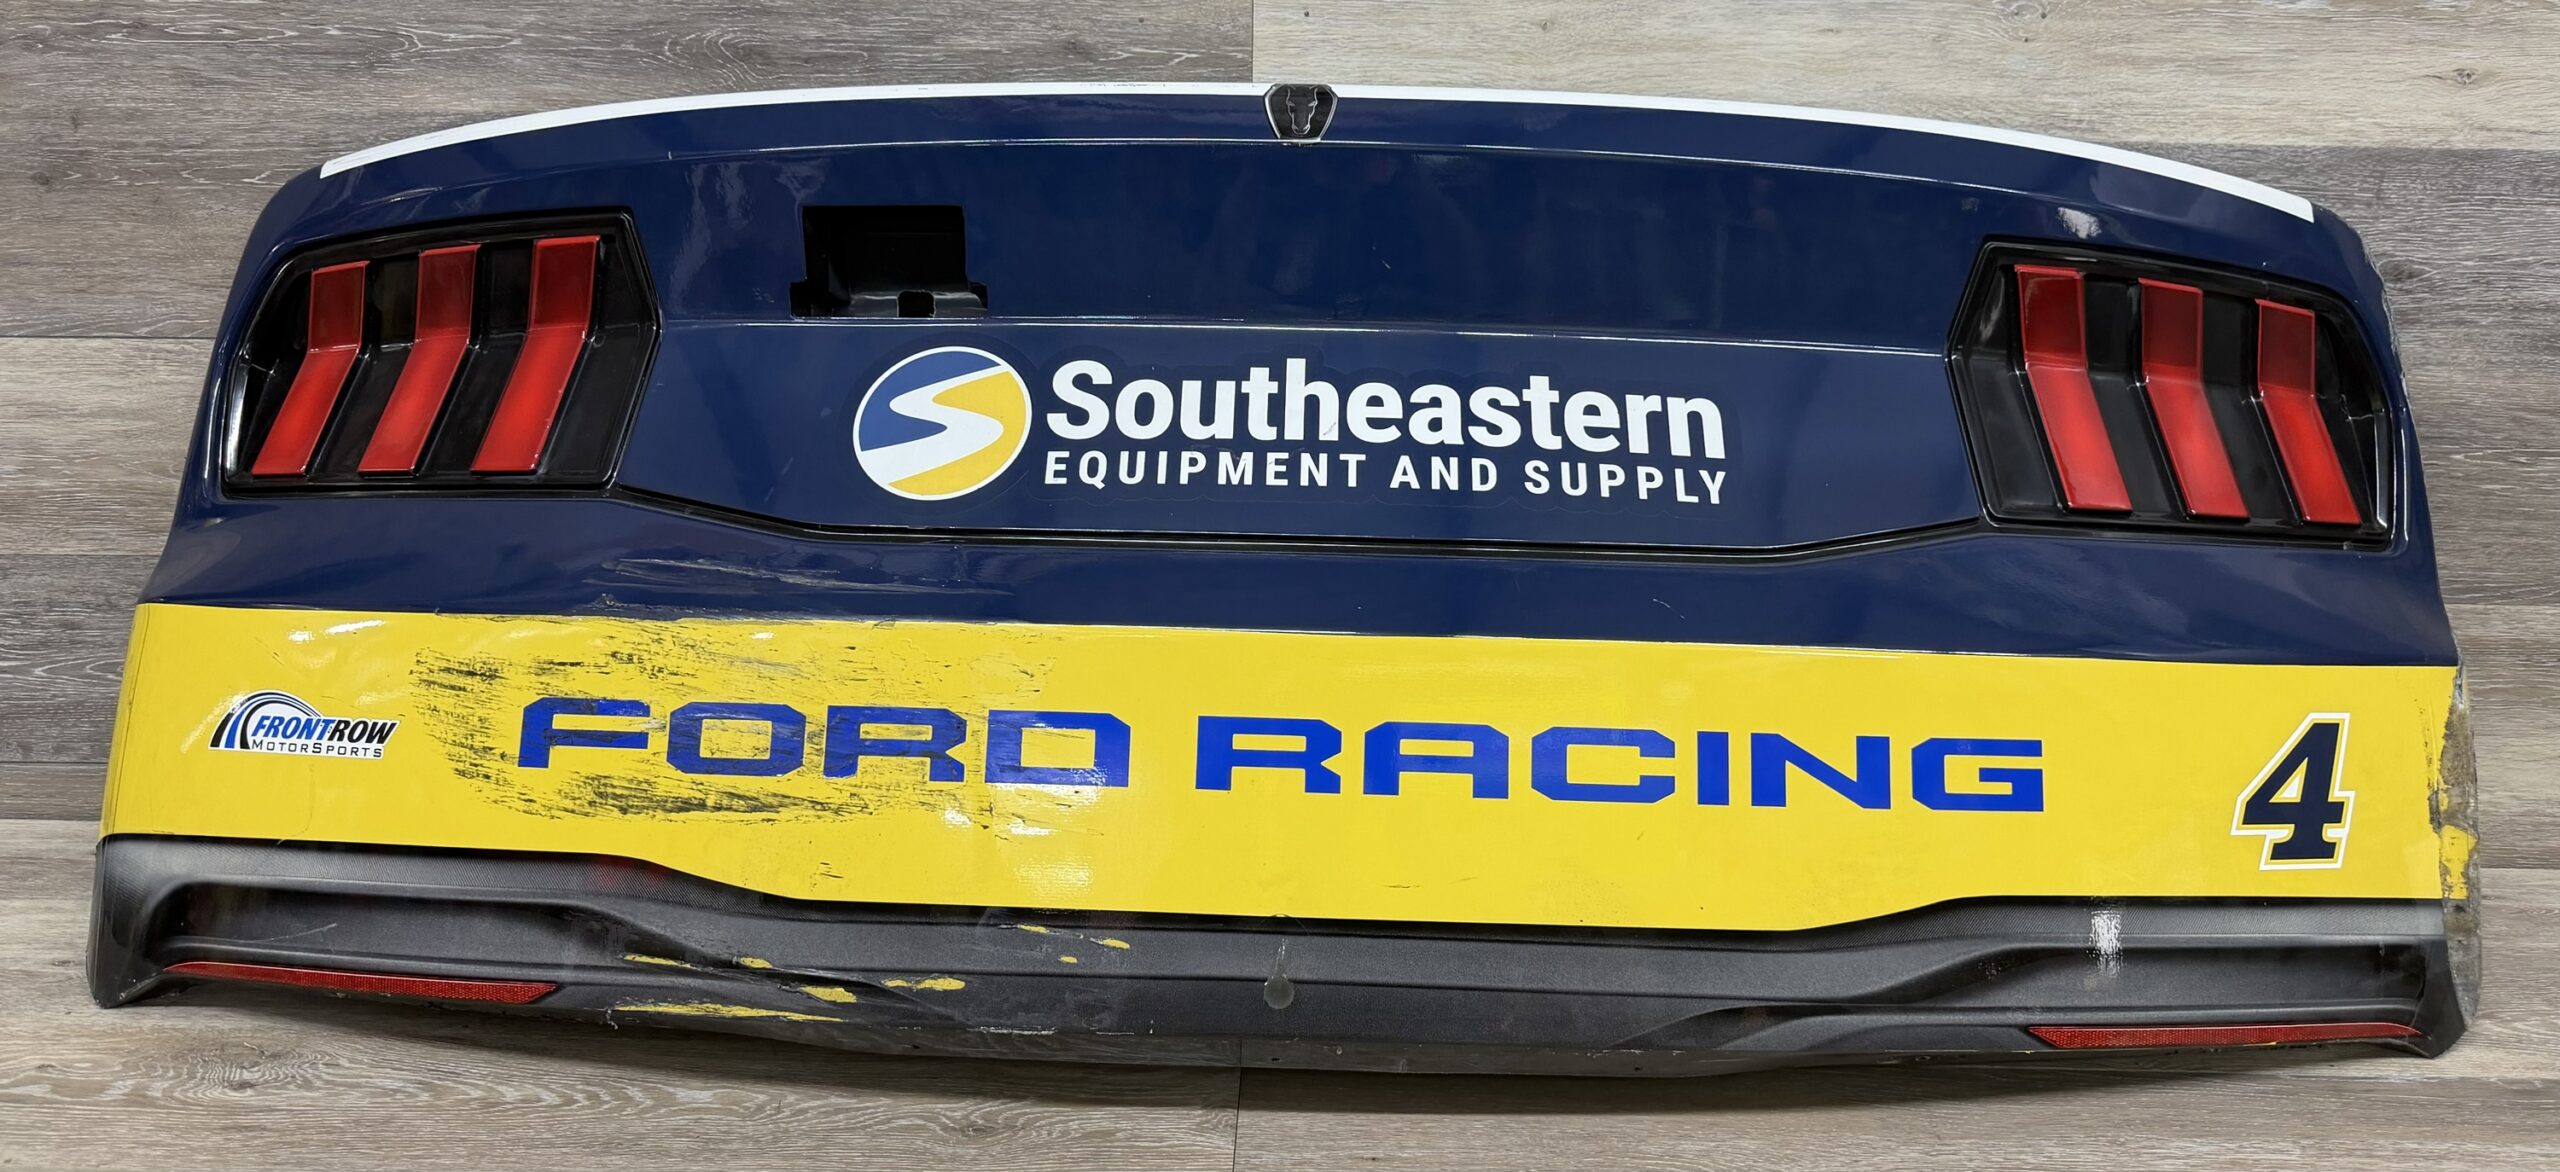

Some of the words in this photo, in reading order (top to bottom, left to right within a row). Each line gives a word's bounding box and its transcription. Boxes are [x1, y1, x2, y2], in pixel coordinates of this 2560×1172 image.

[1045, 356, 1727, 461] Southeastern
[1044, 449, 1368, 491] EQUIPMENT
[1389, 454, 1498, 493] AND
[1524, 458, 1728, 506] SUPPLY
[518, 696, 1132, 788] FORD
[1195, 715, 2044, 813] RACING
[2234, 715, 2352, 867] 4
